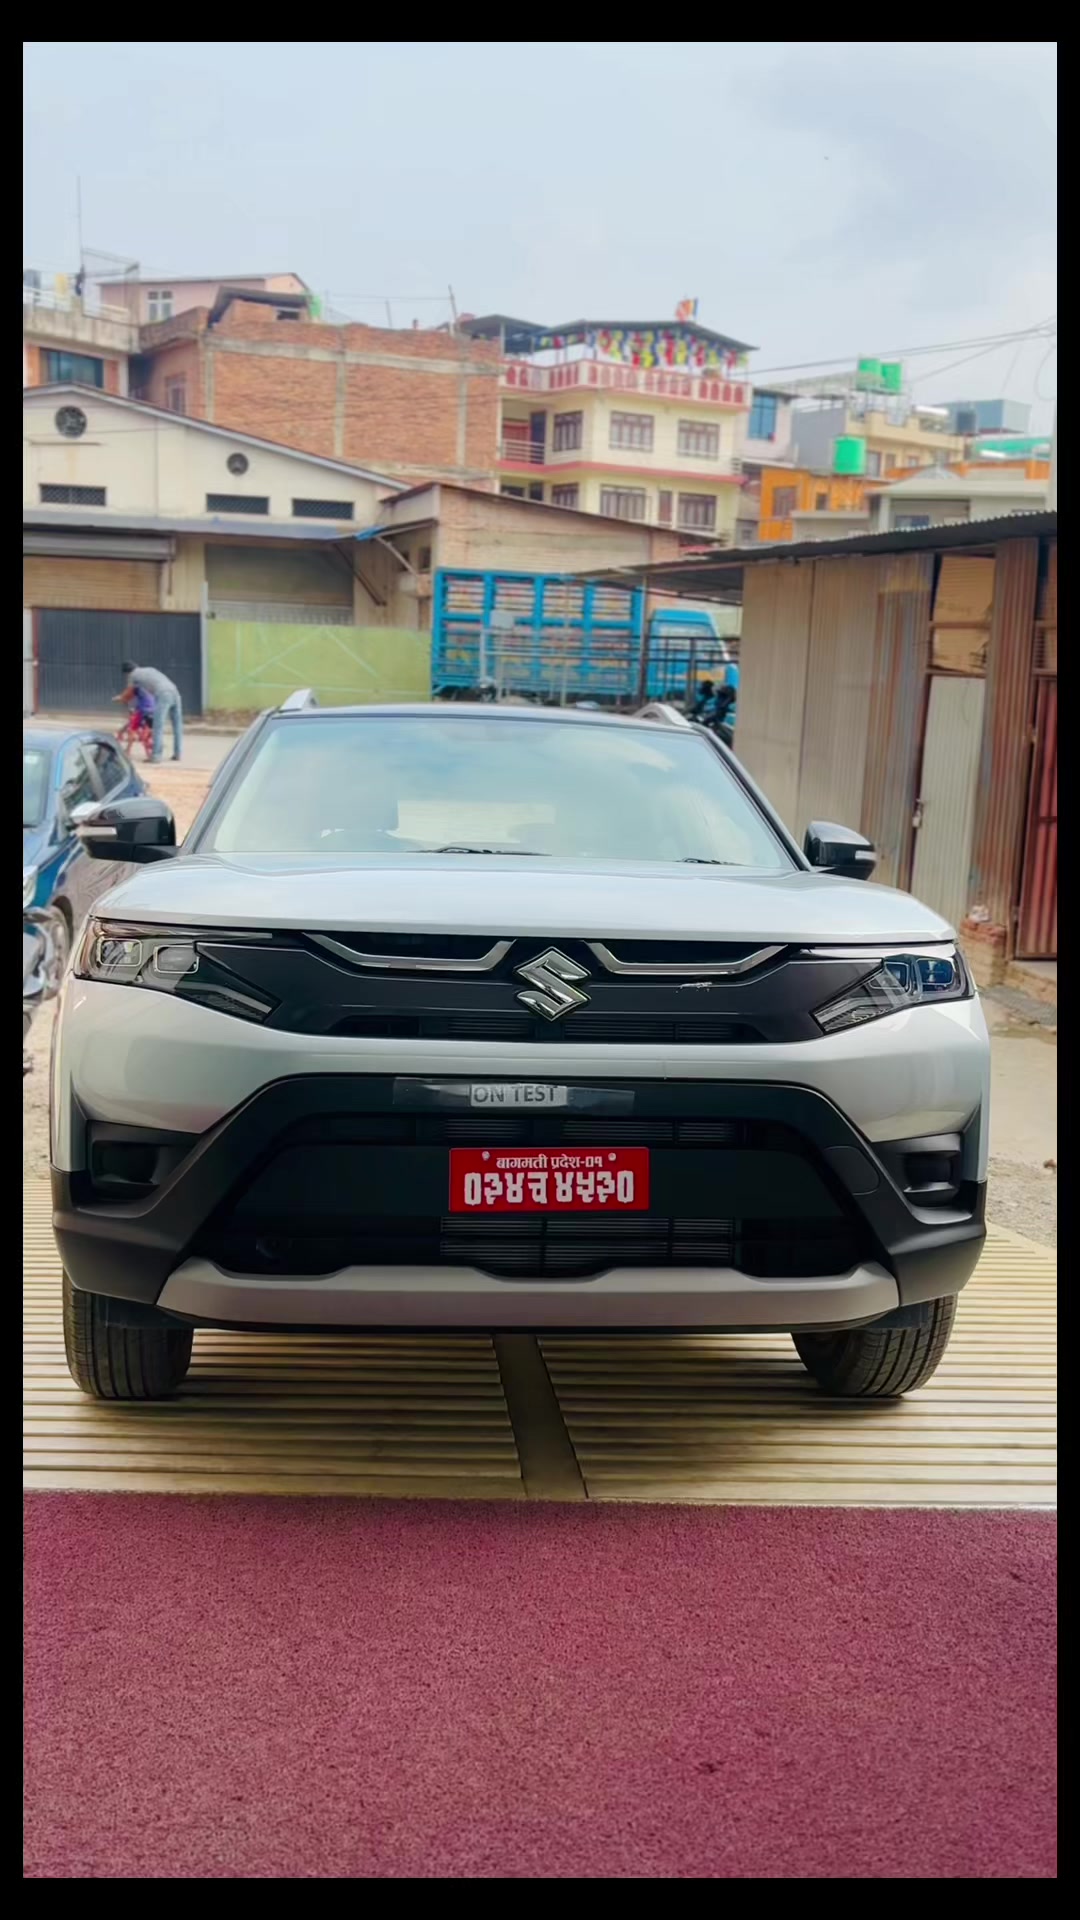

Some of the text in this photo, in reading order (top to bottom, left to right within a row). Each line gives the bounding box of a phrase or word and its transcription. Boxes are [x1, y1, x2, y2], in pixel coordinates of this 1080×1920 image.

[473, 1085, 558, 1103] ON TEST
[496, 1154, 548, 1169] बागमती
